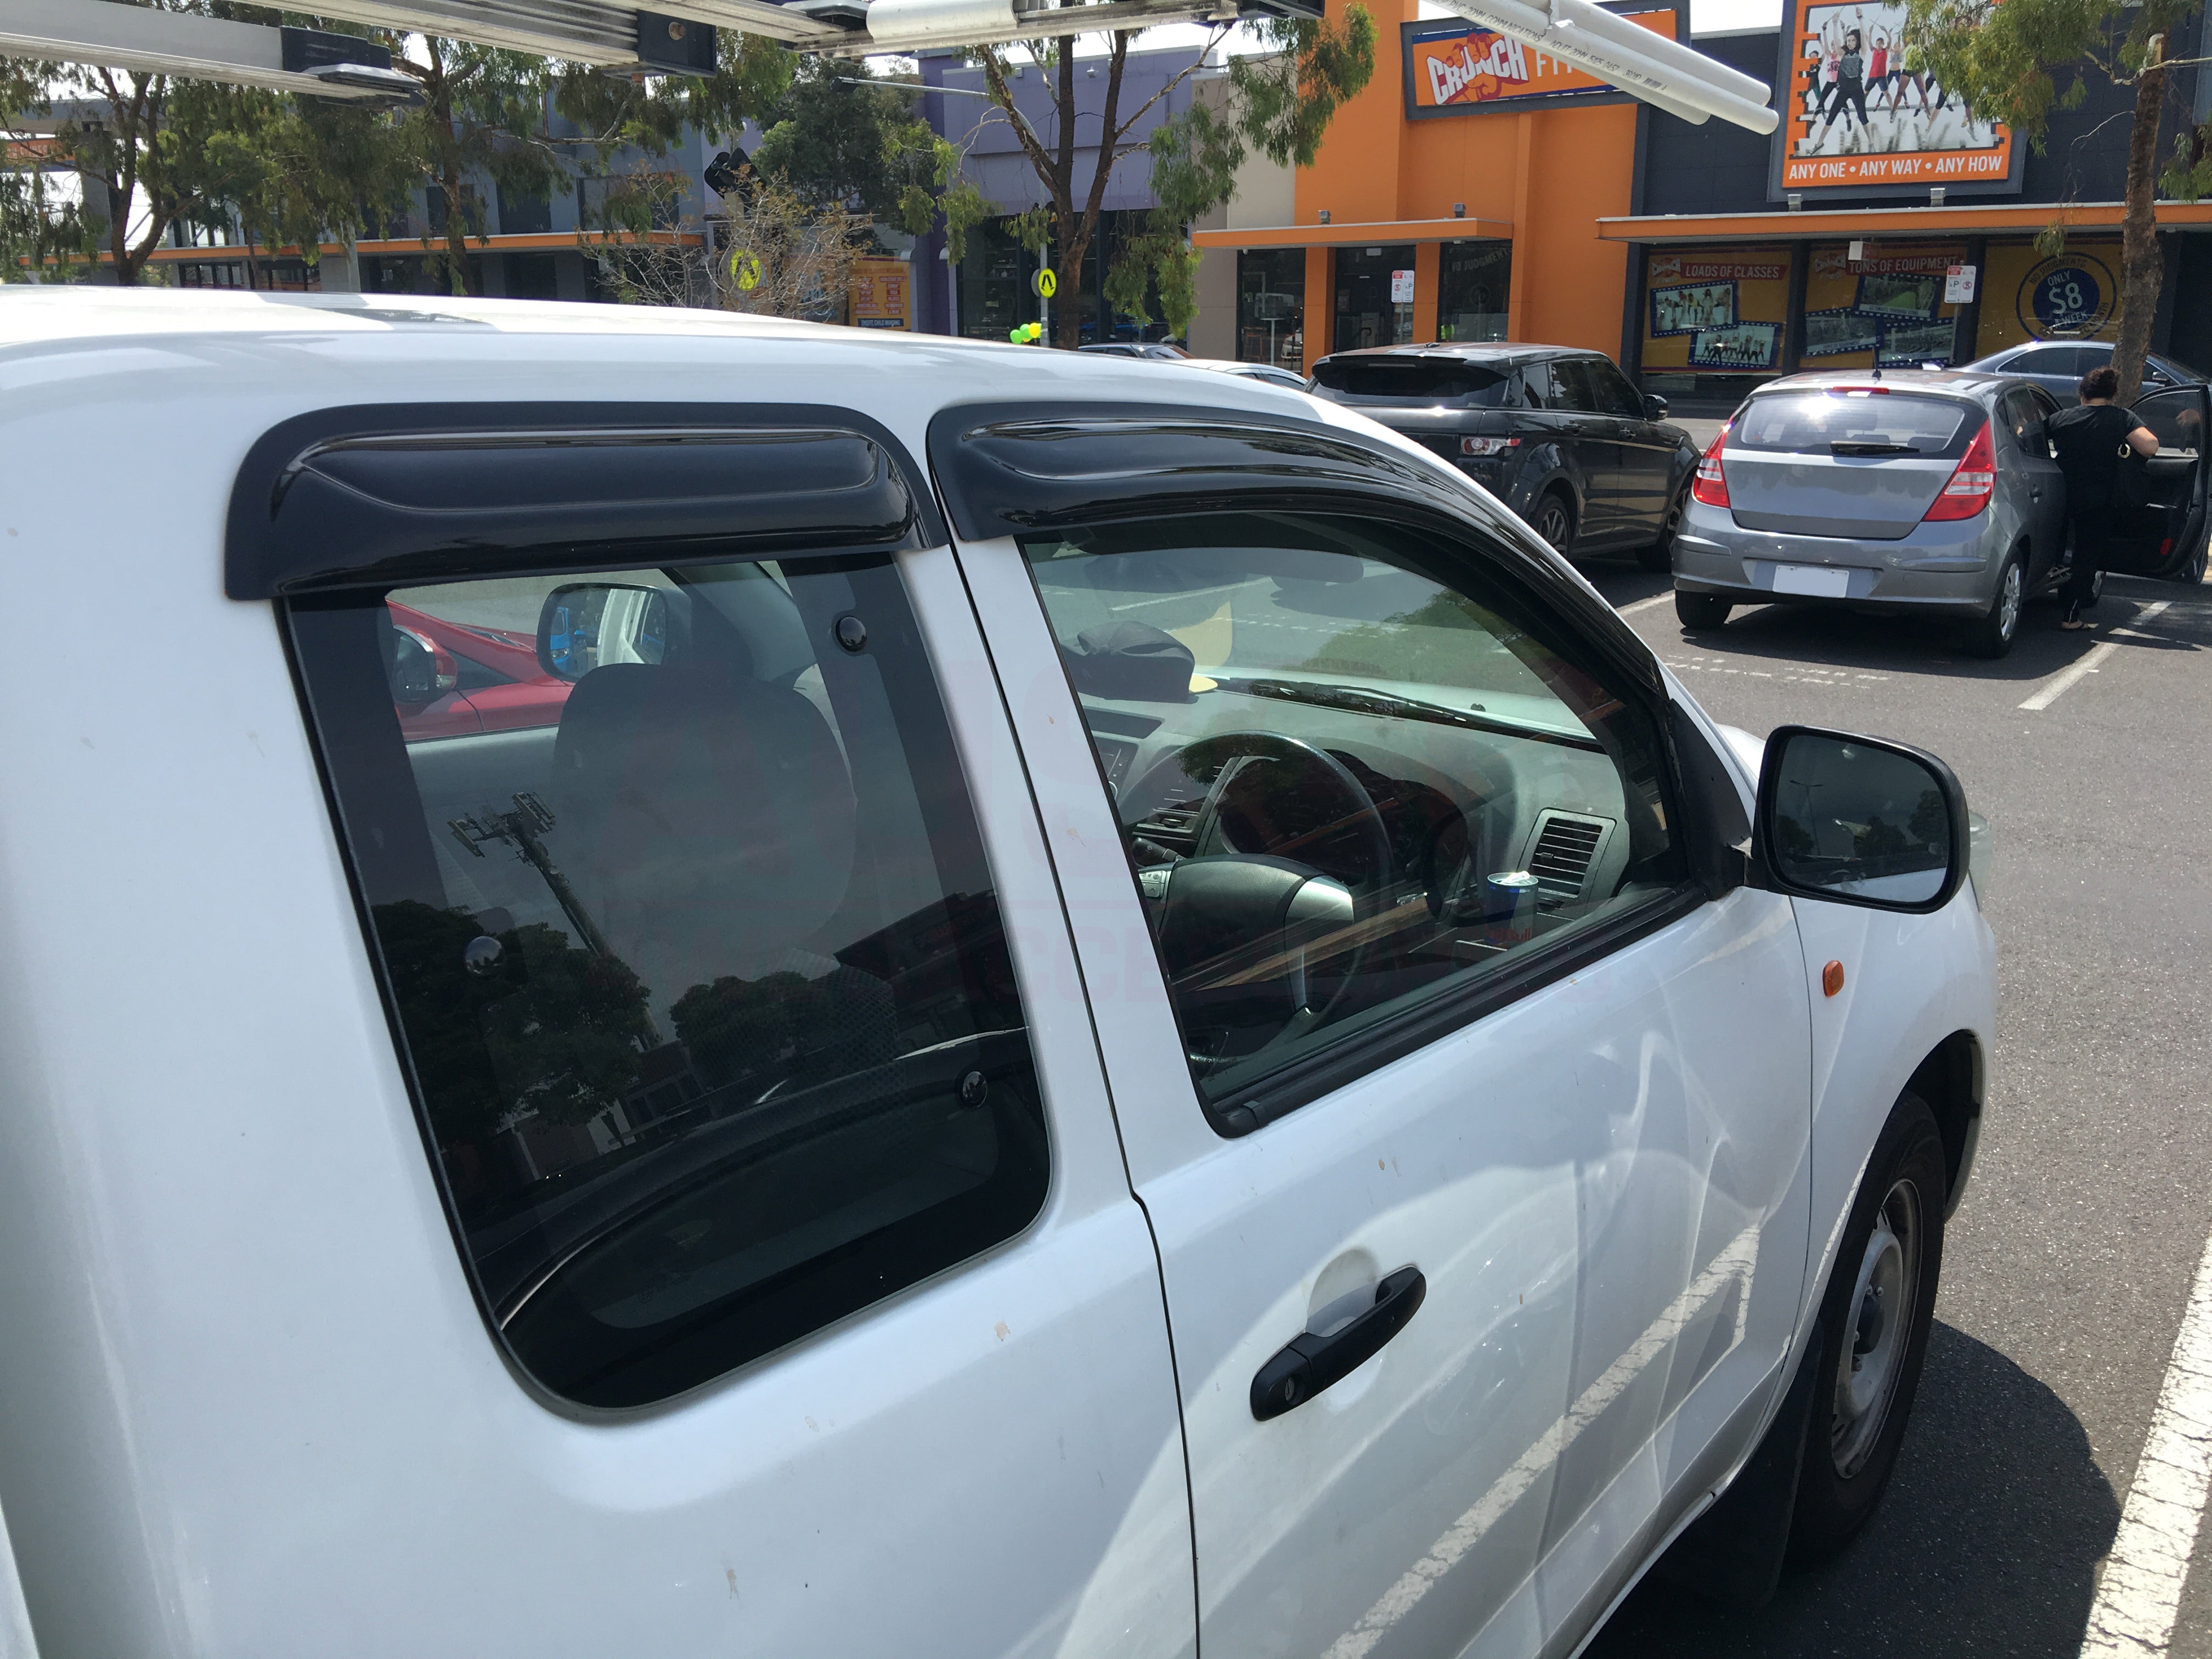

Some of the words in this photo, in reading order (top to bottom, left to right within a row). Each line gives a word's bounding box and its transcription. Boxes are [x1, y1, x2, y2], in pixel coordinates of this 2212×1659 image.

[1426, 34, 1530, 105] CRUNCH
[1788, 163, 1815, 179] ANY
[1820, 162, 1846, 178] ONE
[1859, 160, 1888, 176] ANY
[1891, 159, 1922, 175] WAY
[1935, 156, 1966, 174] ANY
[1968, 155, 2002, 172] HOW
[1685, 265, 1718, 276] LOADS
[1720, 264, 1733, 276] OF
[1734, 266, 1780, 278] CLASSES
[1848, 260, 1877, 273] TONS
[1880, 259, 1894, 272] OF
[1895, 256, 1958, 272] EQUIPMENT
[2047, 270, 2071, 286] ONLY
[2048, 282, 2083, 314] $8
[2061, 310, 2089, 325] WEEK
